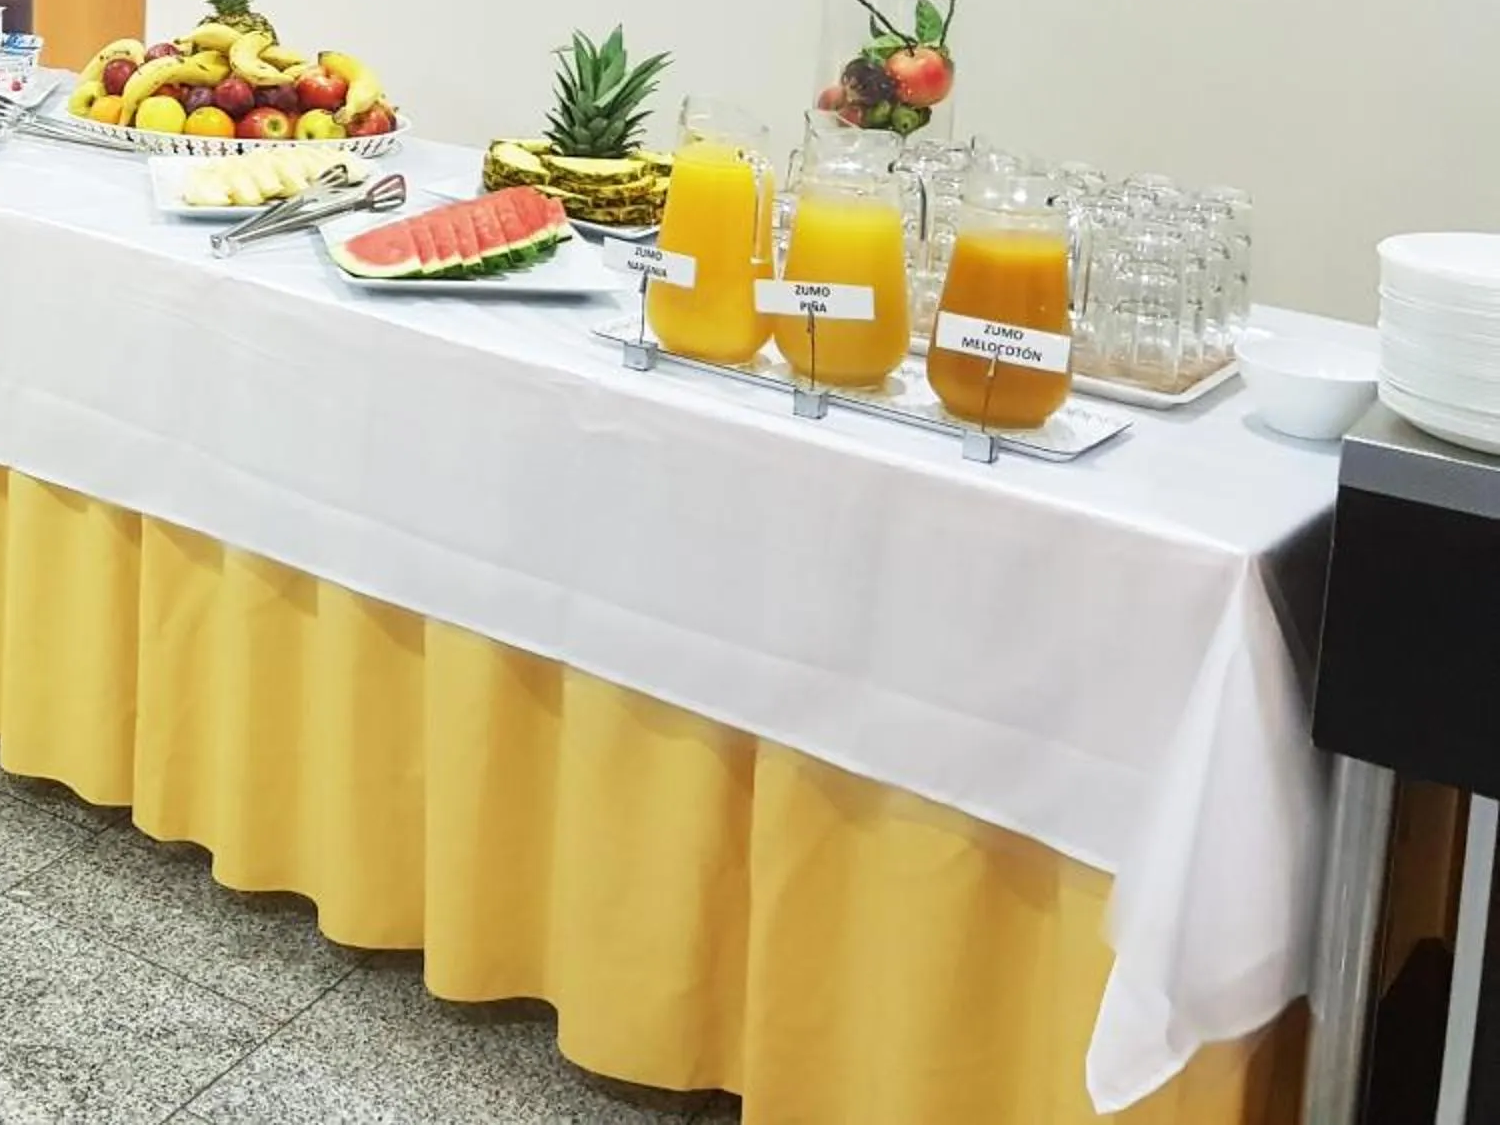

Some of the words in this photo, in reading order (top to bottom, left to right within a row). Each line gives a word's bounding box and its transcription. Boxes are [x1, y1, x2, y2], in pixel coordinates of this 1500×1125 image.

[634, 246, 663, 262] ZUMO
[794, 284, 832, 298] ZUMO
[799, 300, 827, 313] PIÑA
[983, 323, 1025, 341] ZUMO
[961, 336, 1043, 363] MELOCOTÓN
